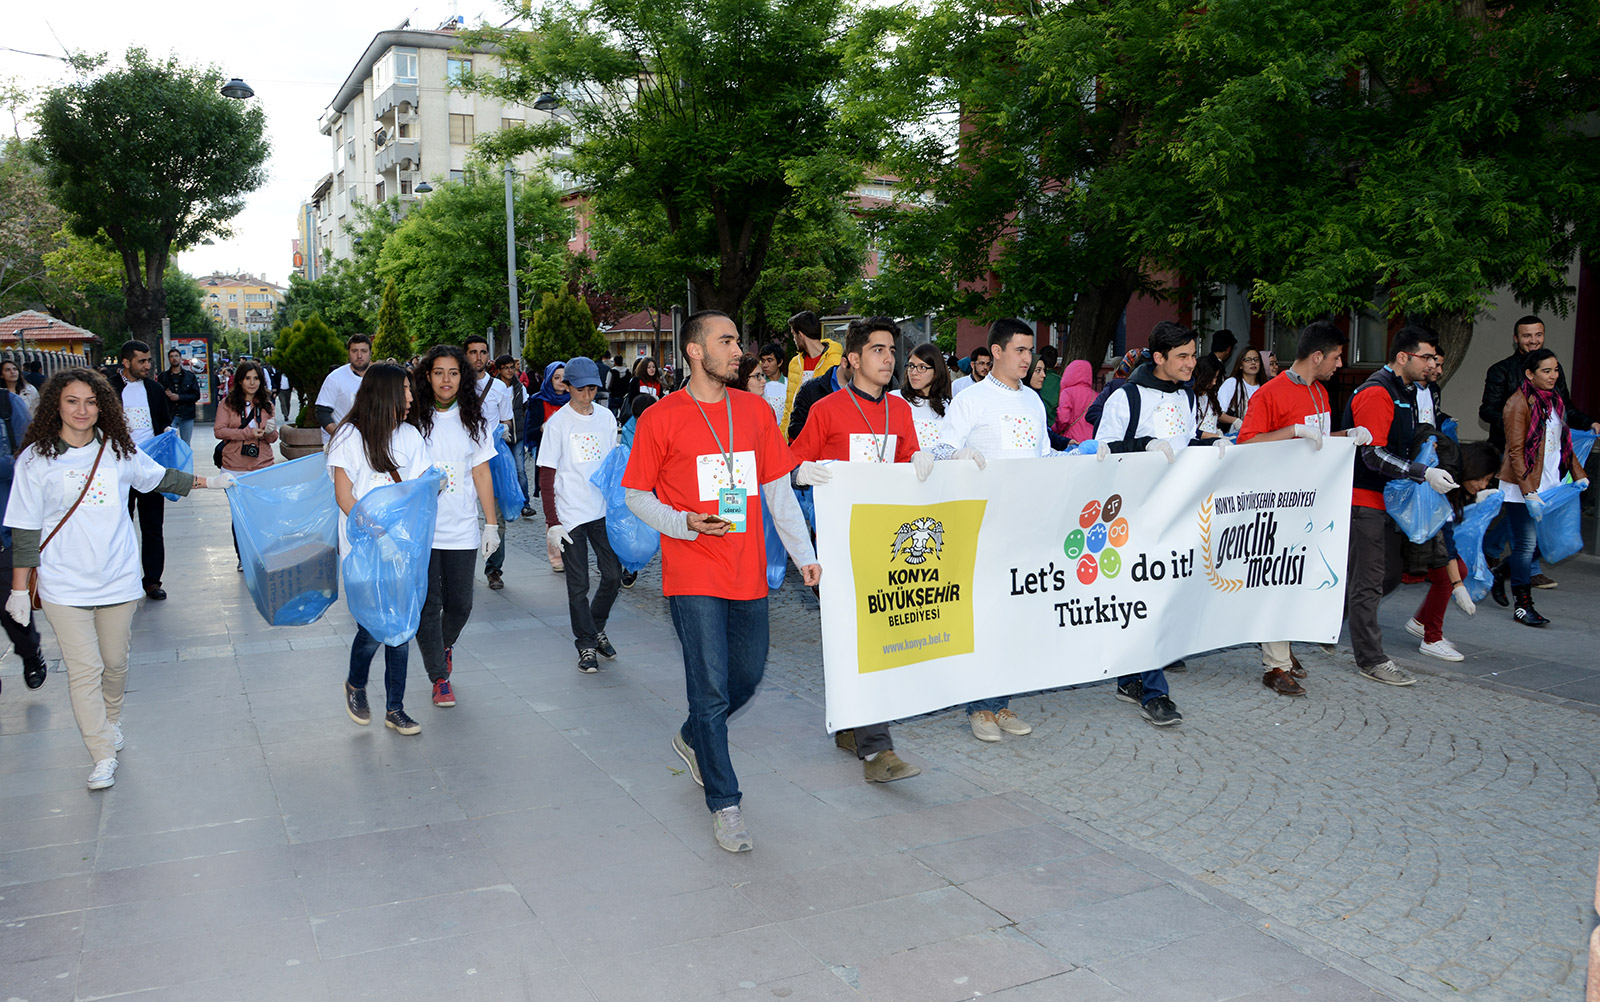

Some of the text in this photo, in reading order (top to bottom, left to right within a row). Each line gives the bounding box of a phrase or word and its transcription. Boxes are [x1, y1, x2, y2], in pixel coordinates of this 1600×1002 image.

[1277, 488, 1317, 508] BELEDİYESİ
[1215, 511, 1278, 570] gençlik
[888, 568, 939, 586] KONYA
[1010, 548, 1195, 595] Let's do it!
[1246, 546, 1307, 588] meclisi
[867, 581, 960, 614] BÜYÜKŞEHİR
[1054, 595, 1148, 629] Türkiye
[888, 605, 941, 627] BELEDİYESİ
[882, 632, 951, 655] www.konya.bel.tr
